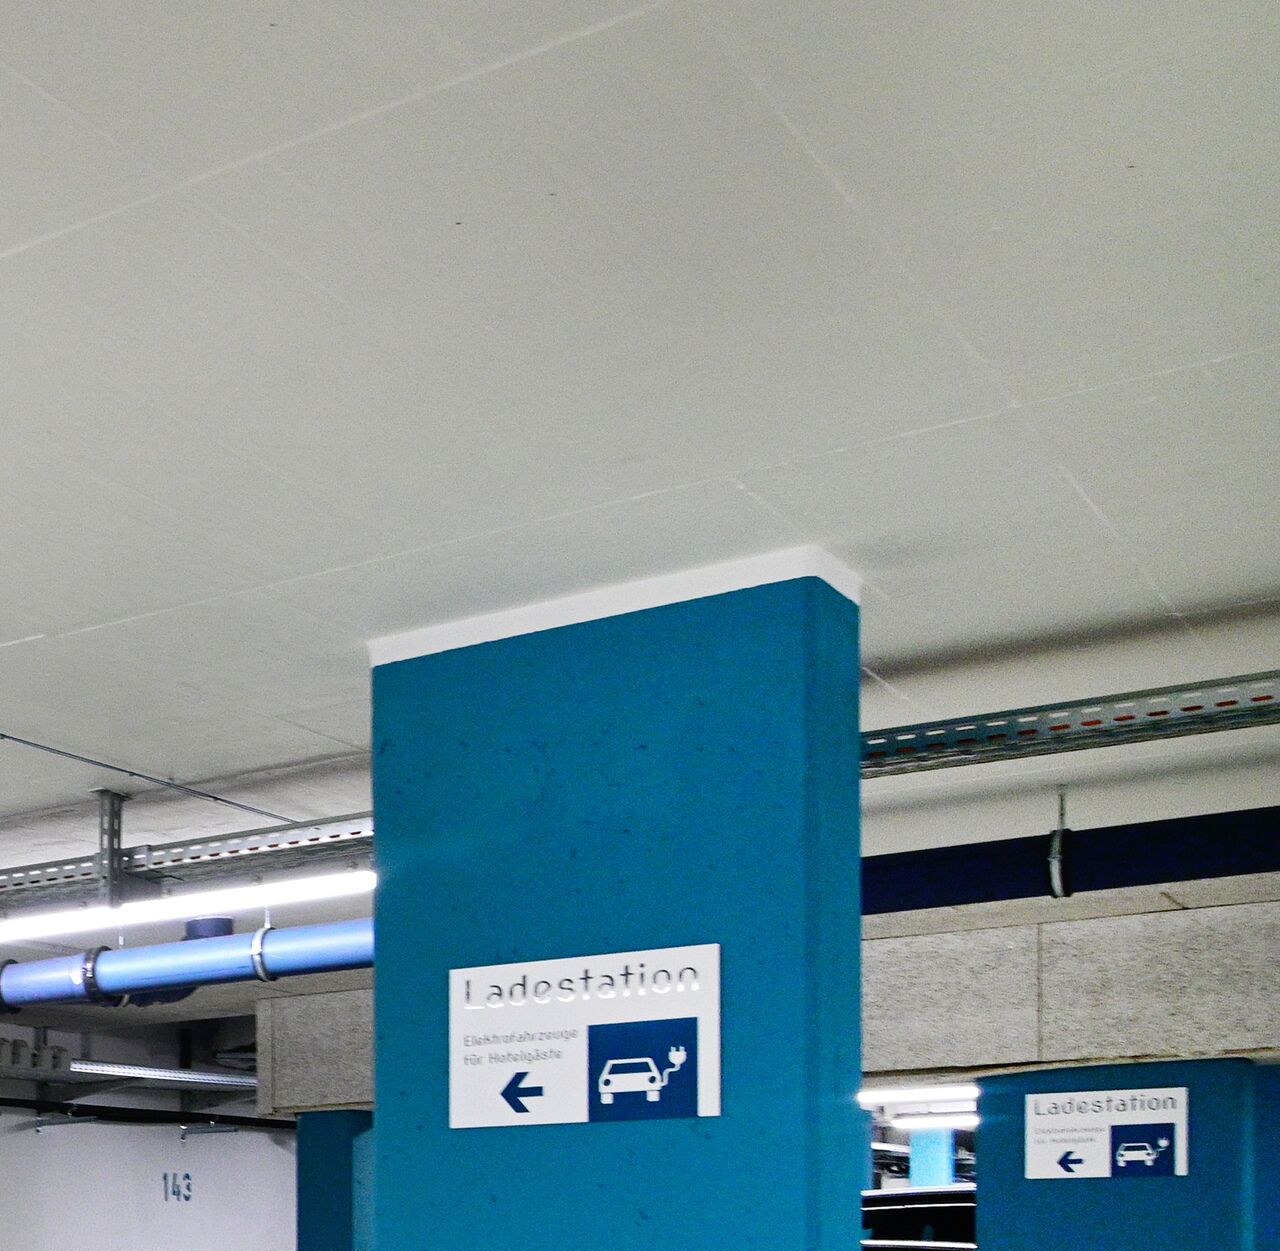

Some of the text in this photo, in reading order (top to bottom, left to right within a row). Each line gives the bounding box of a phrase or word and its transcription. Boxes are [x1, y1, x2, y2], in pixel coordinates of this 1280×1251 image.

[464, 963, 700, 1009] Ladestation
[1034, 1094, 1178, 1116] Ladestation
[162, 1172, 192, 1201] 143
